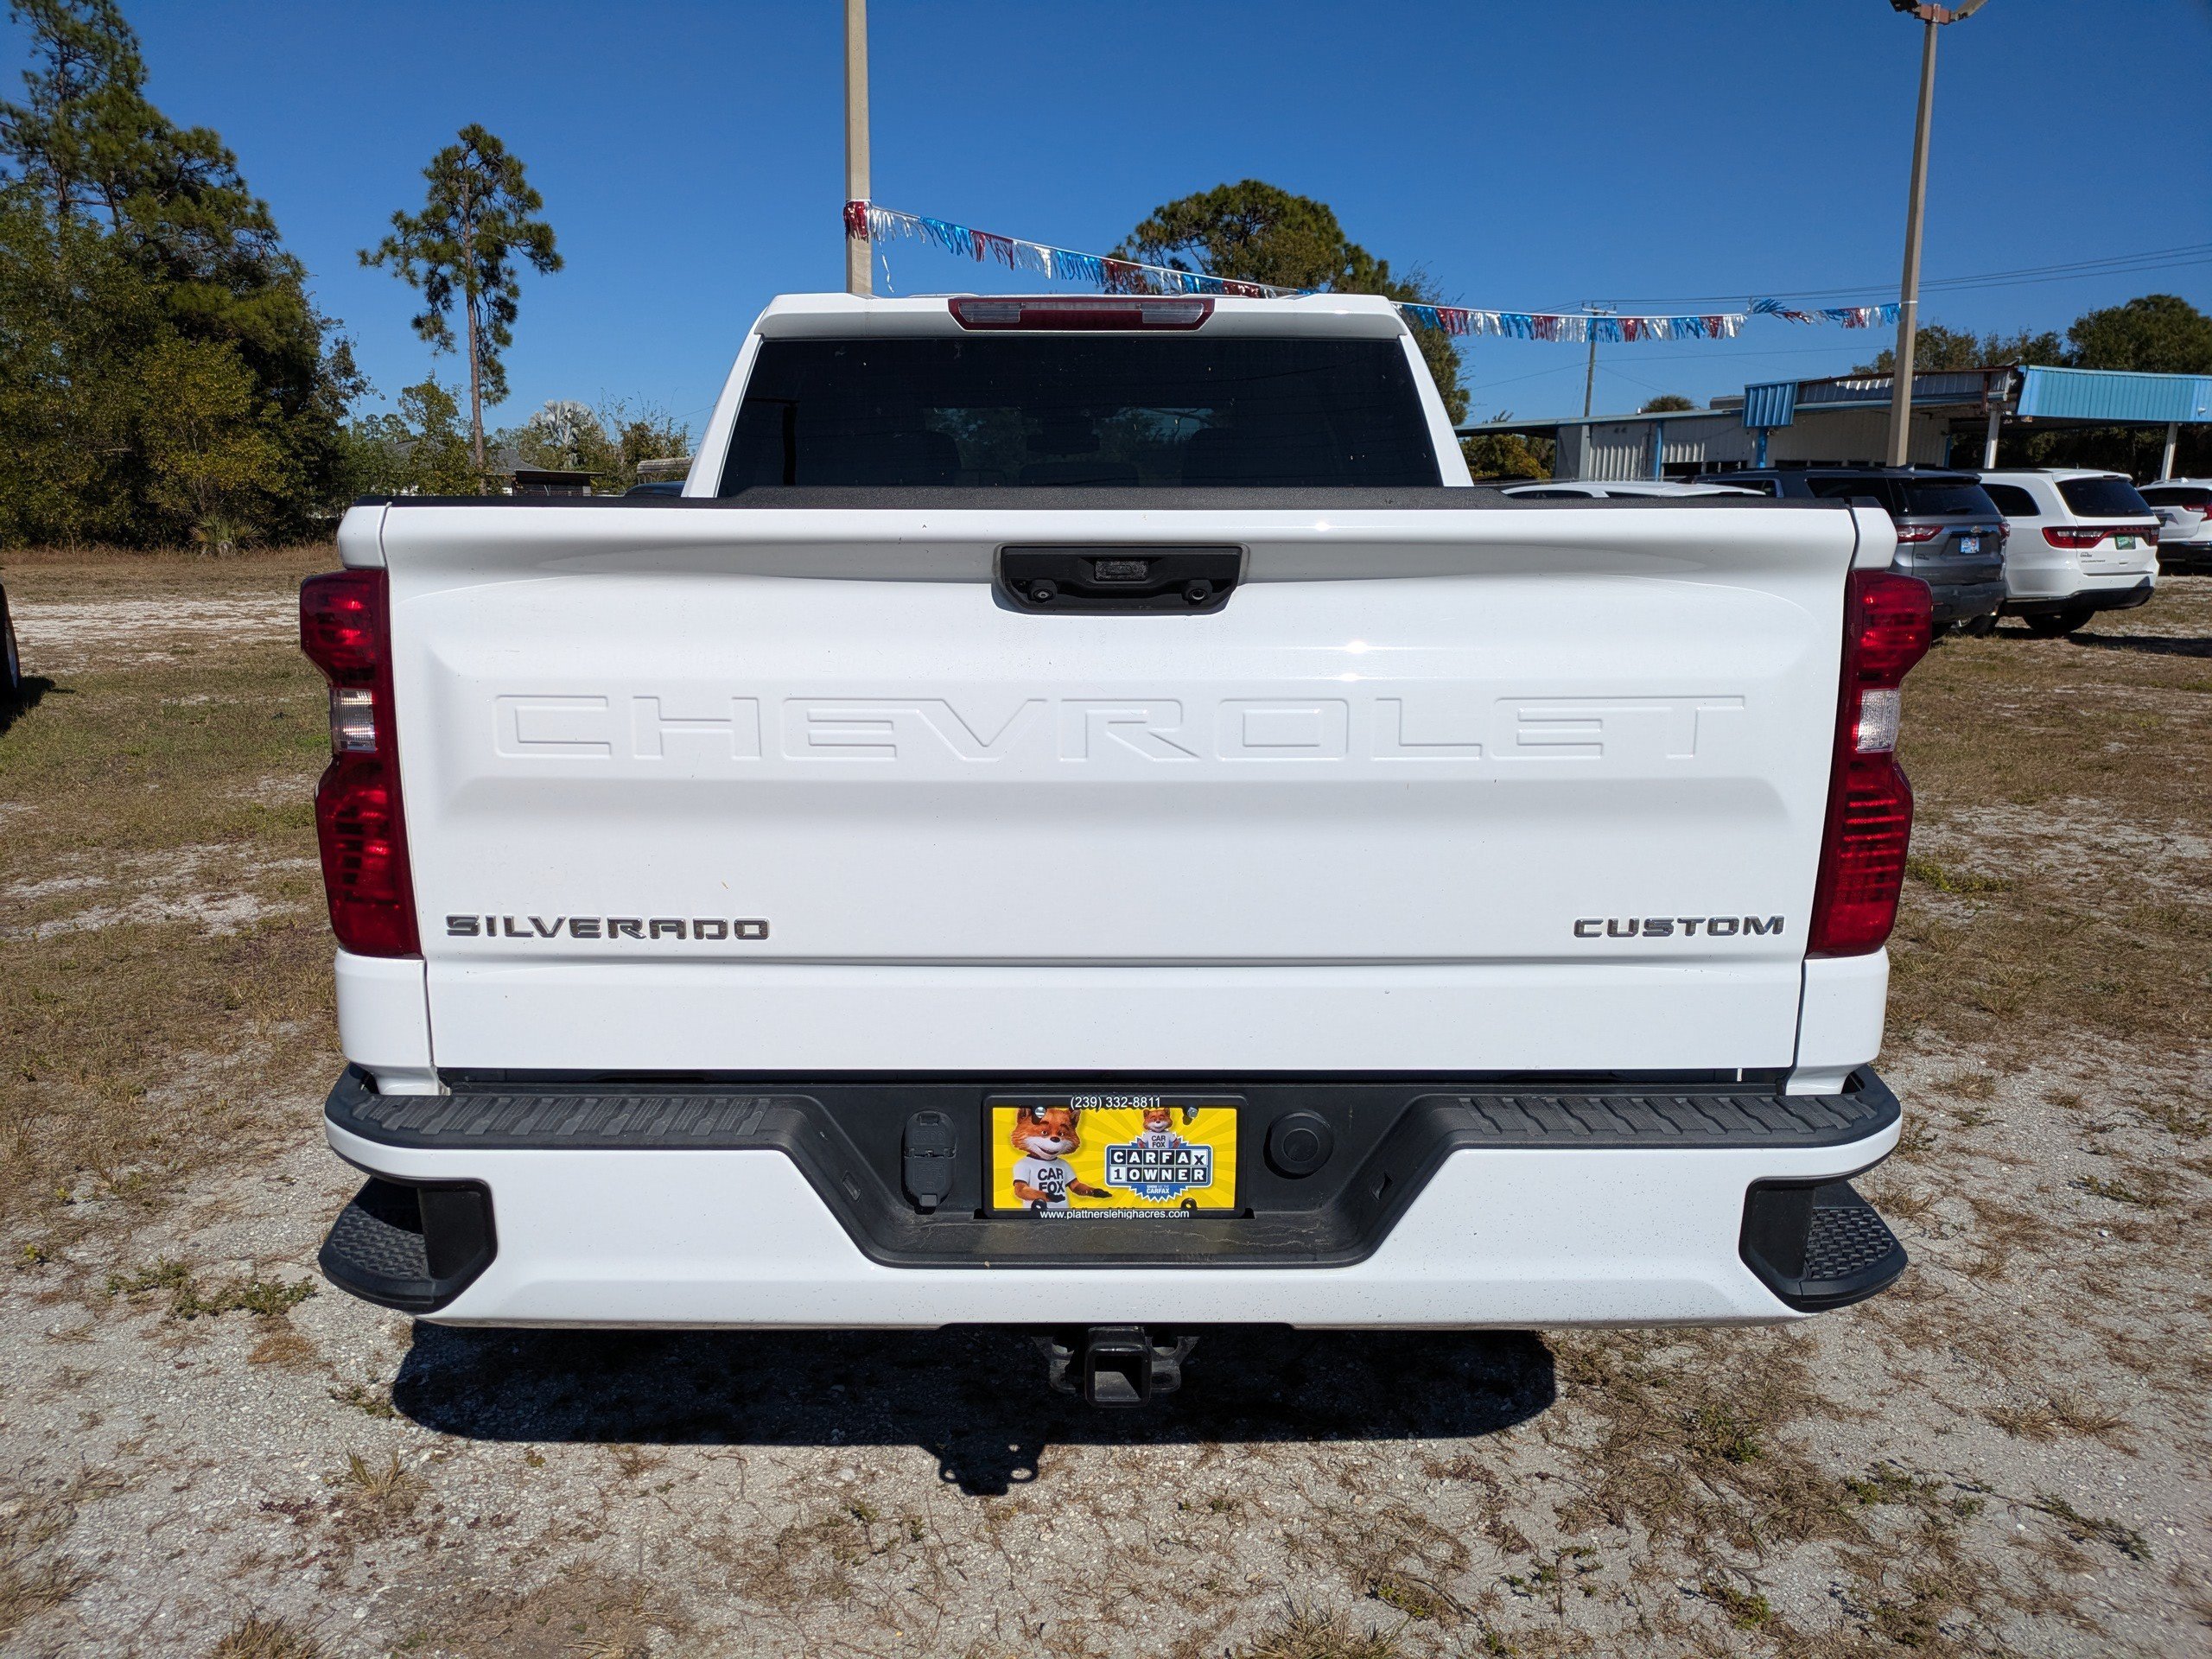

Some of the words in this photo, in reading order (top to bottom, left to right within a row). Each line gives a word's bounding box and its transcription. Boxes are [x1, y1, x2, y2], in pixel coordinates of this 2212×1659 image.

[494, 694, 1745, 761] CHEVROLET
[445, 914, 771, 940] SILVERADO
[1573, 915, 1785, 938] CUSTOM
[1071, 1096, 1103, 1110] (239)
[1105, 1096, 1160, 1108] 332-8811
[1113, 1151, 1205, 1165] CARFAX
[1037, 1167, 1064, 1180] CAR
[1128, 1168, 1205, 1180] OWNER
[1039, 1180, 1065, 1193] FOX
[1039, 1209, 1190, 1220] www.plattnerslehighacres.com
